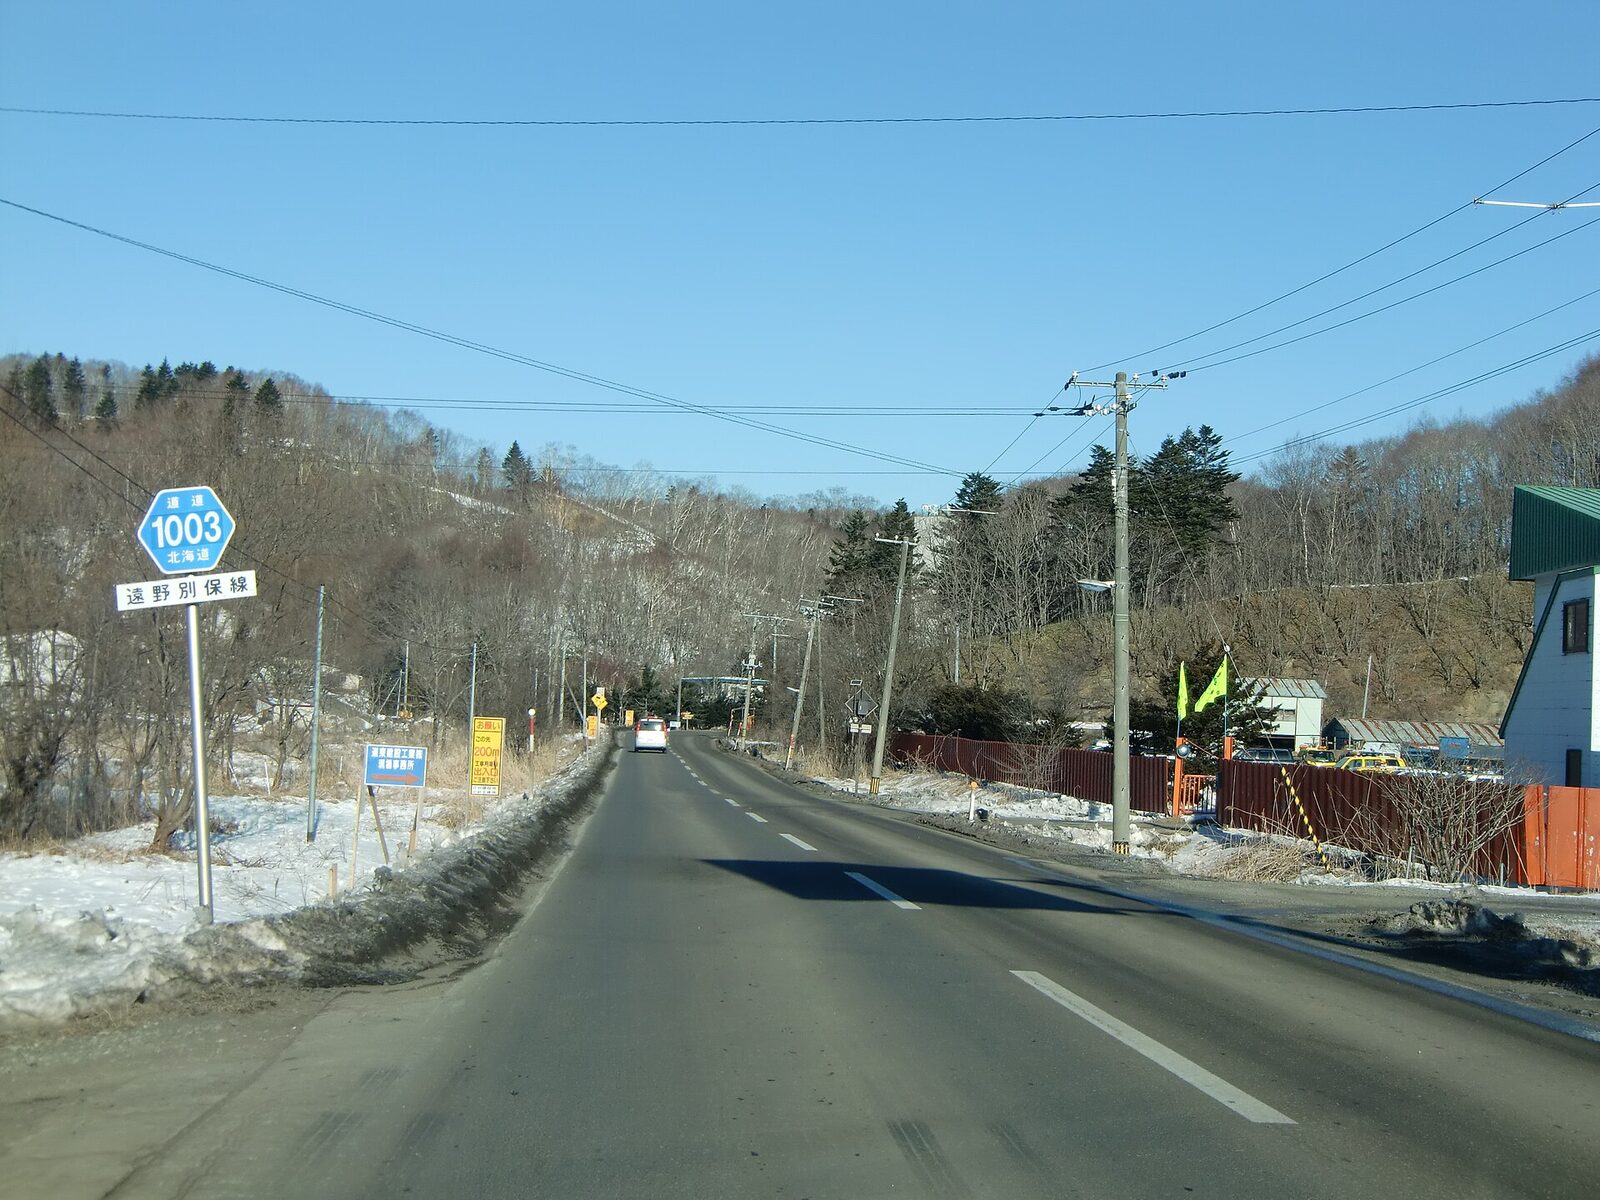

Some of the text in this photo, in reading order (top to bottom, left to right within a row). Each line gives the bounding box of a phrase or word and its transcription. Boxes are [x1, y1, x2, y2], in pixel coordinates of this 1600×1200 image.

[151, 510, 222, 548] 1003
[167, 548, 210, 564] 北海道
[126, 576, 248, 605] 遠野別保線
[476, 721, 500, 730] お願い
[474, 746, 499, 757] 200m
[473, 767, 498, 777] 出入口
